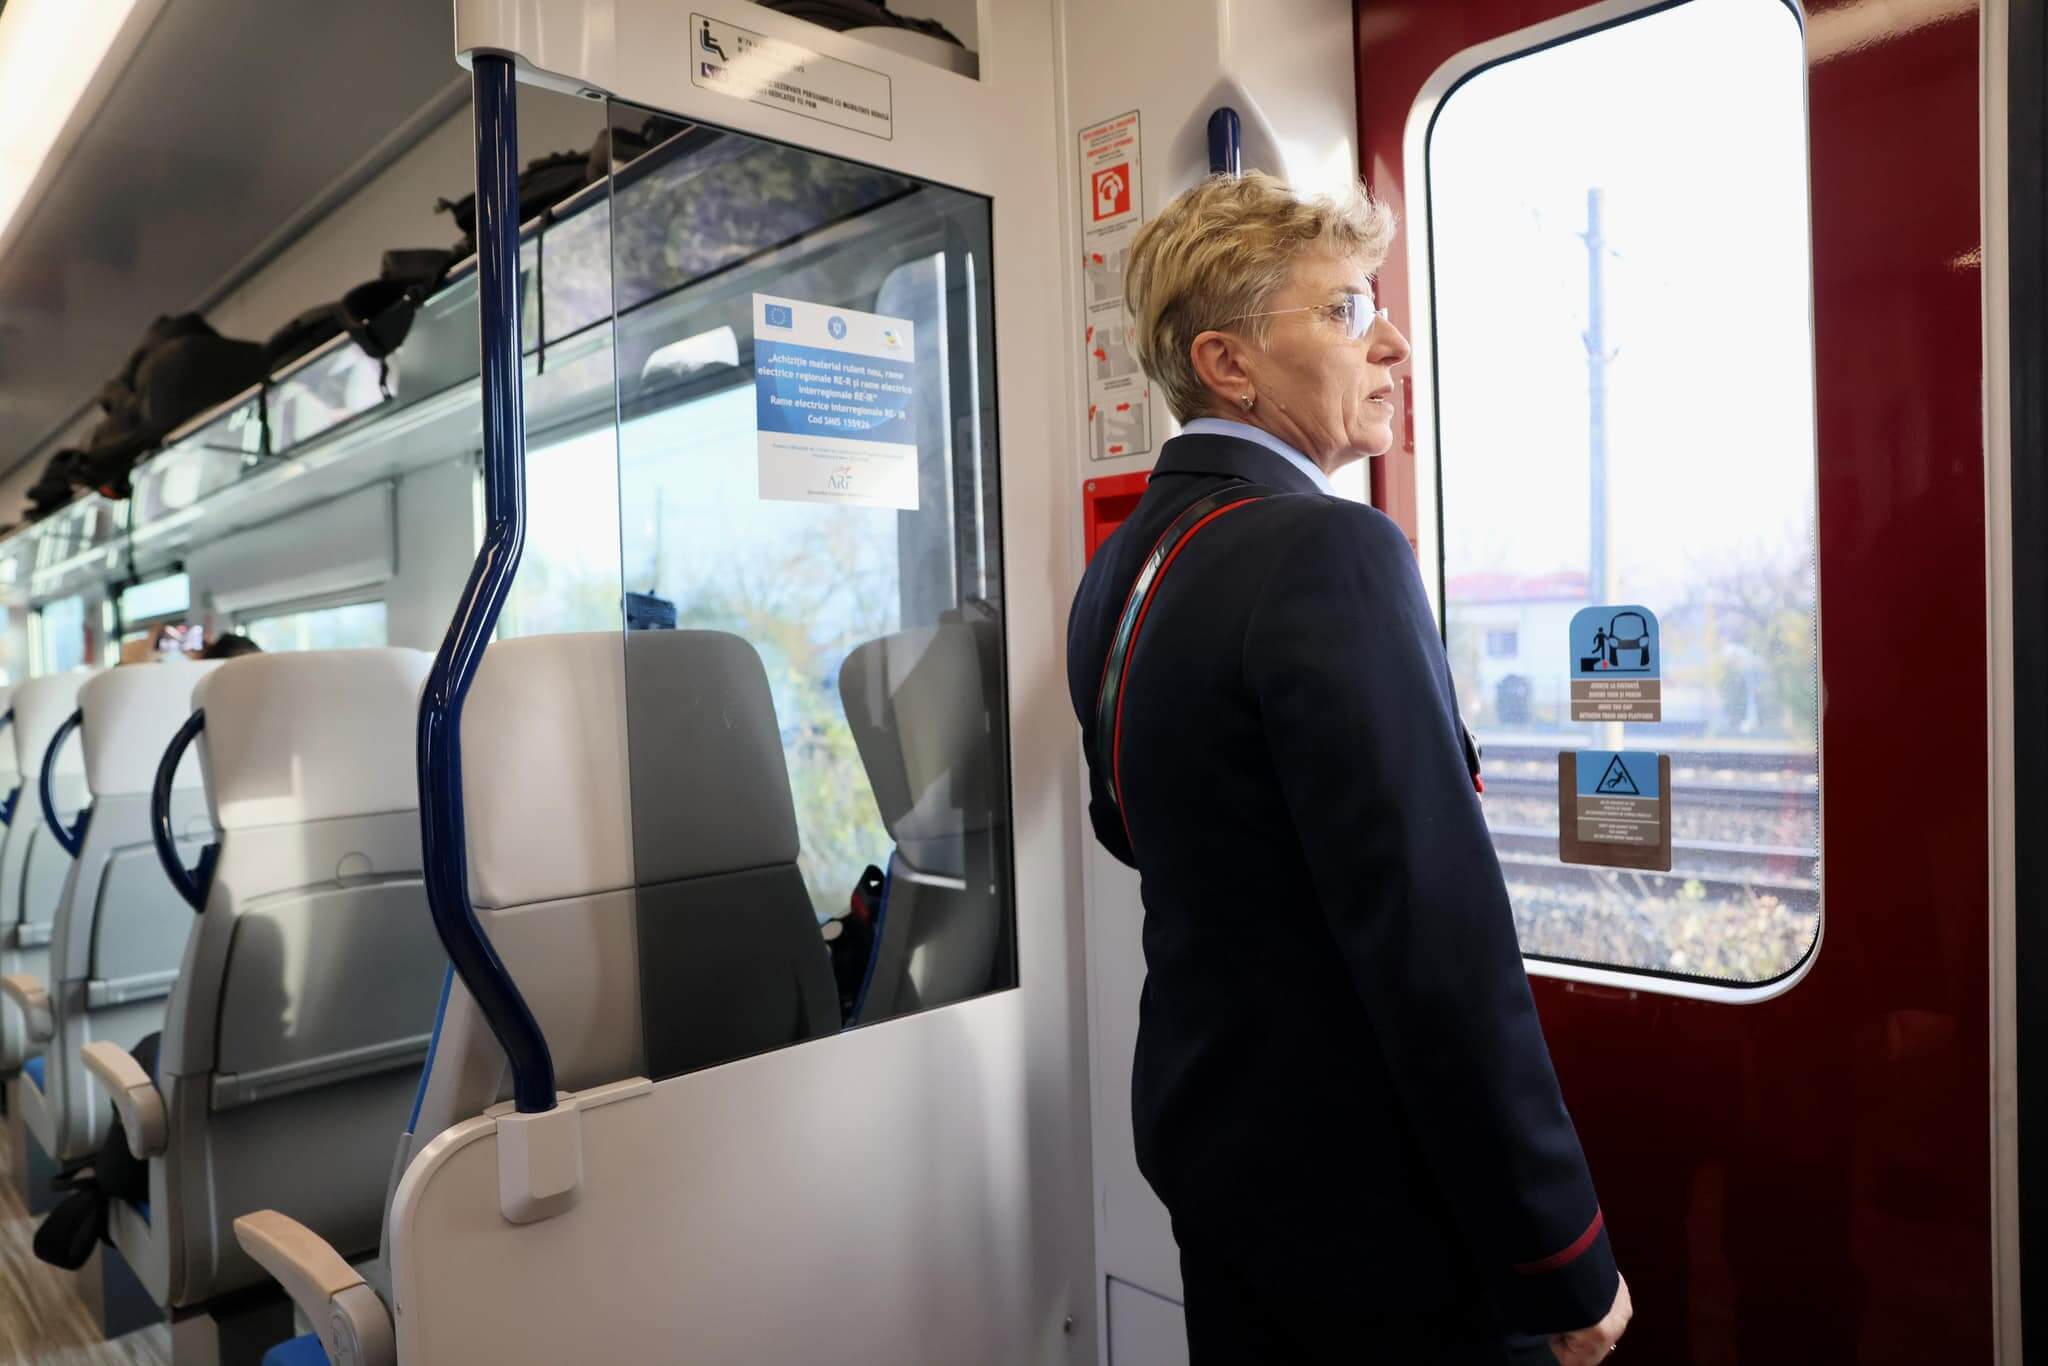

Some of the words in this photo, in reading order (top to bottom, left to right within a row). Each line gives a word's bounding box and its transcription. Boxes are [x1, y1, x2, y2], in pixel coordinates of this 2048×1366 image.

[809, 358, 842, 371] material
[758, 366, 795, 380] electrice
[795, 371, 832, 385] regionale
[770, 395, 793, 407] Rame
[795, 397, 830, 411] electrice
[808, 414, 823, 425] Cod
